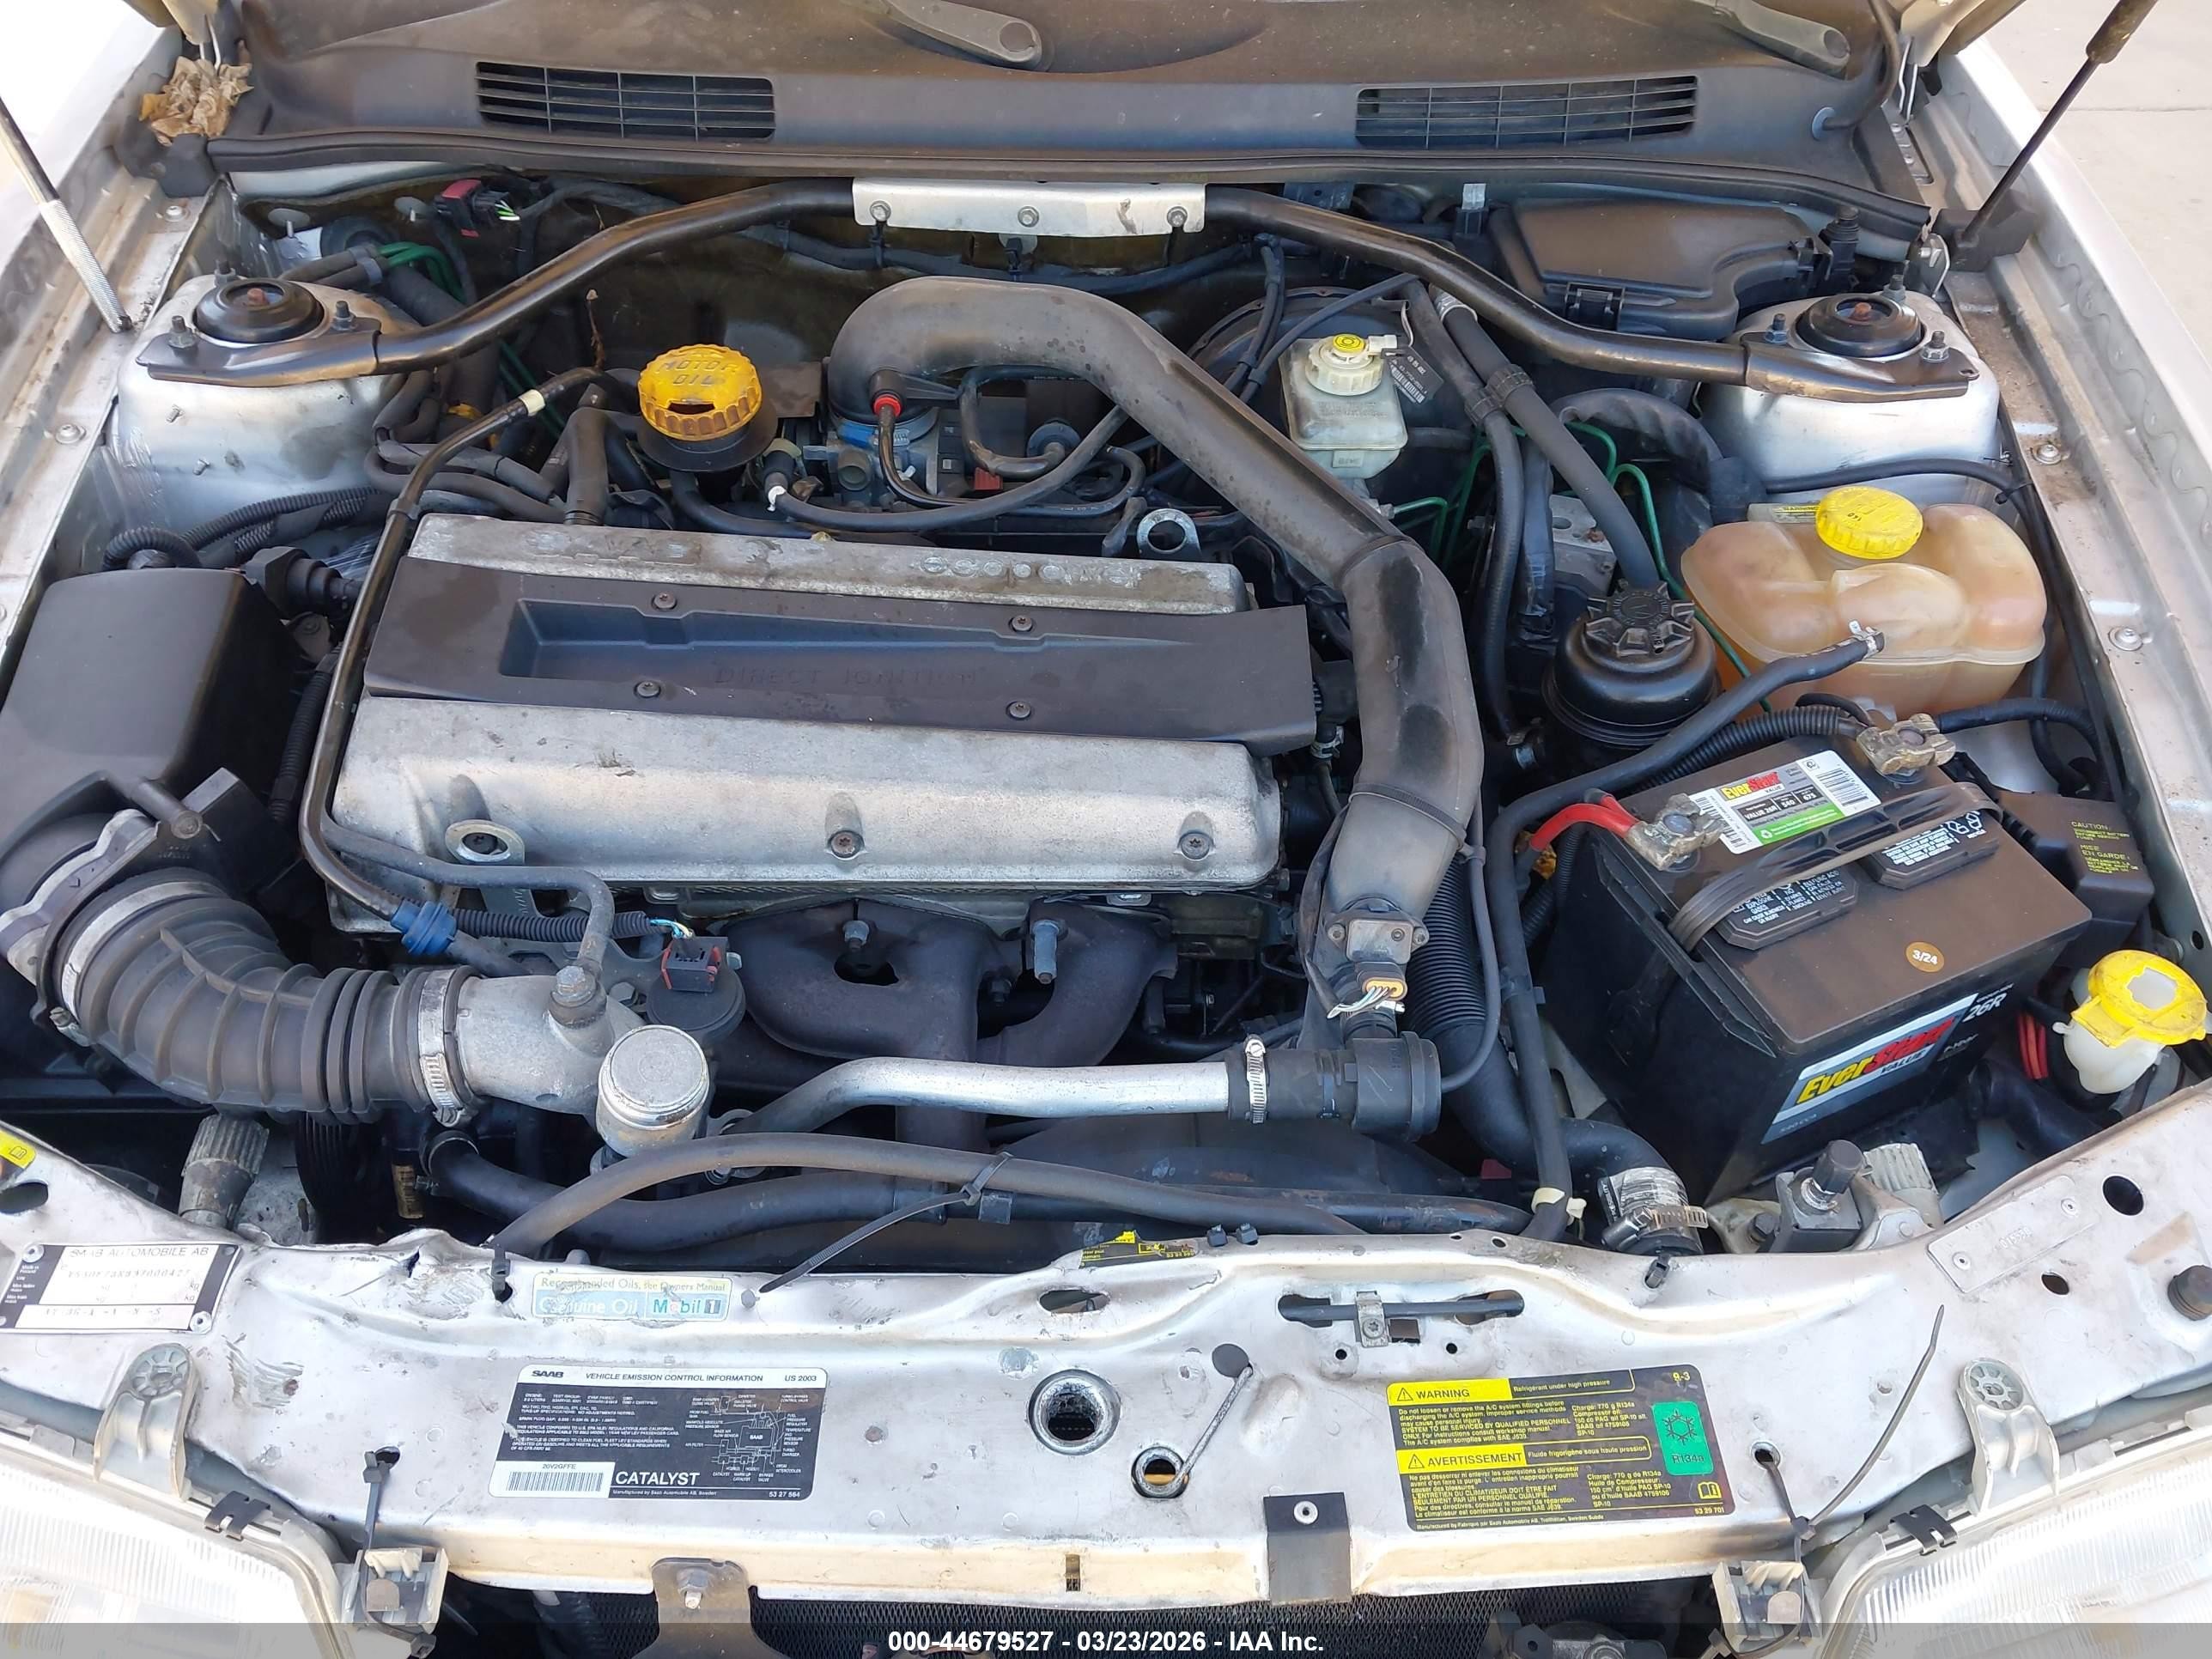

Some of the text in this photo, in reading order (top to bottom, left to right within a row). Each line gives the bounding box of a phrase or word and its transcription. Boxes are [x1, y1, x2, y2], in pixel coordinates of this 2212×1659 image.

[714, 669, 821, 684] DIRECT
[1912, 949, 1939, 966] 3/24
[1962, 993, 2008, 1023] 26R
[611, 1298, 637, 1315] Oil
[1416, 1389, 1470, 1399] WARNING
[1428, 1453, 1522, 1466] AVERTISSEMENT
[615, 1471, 700, 1486] CATALYST
